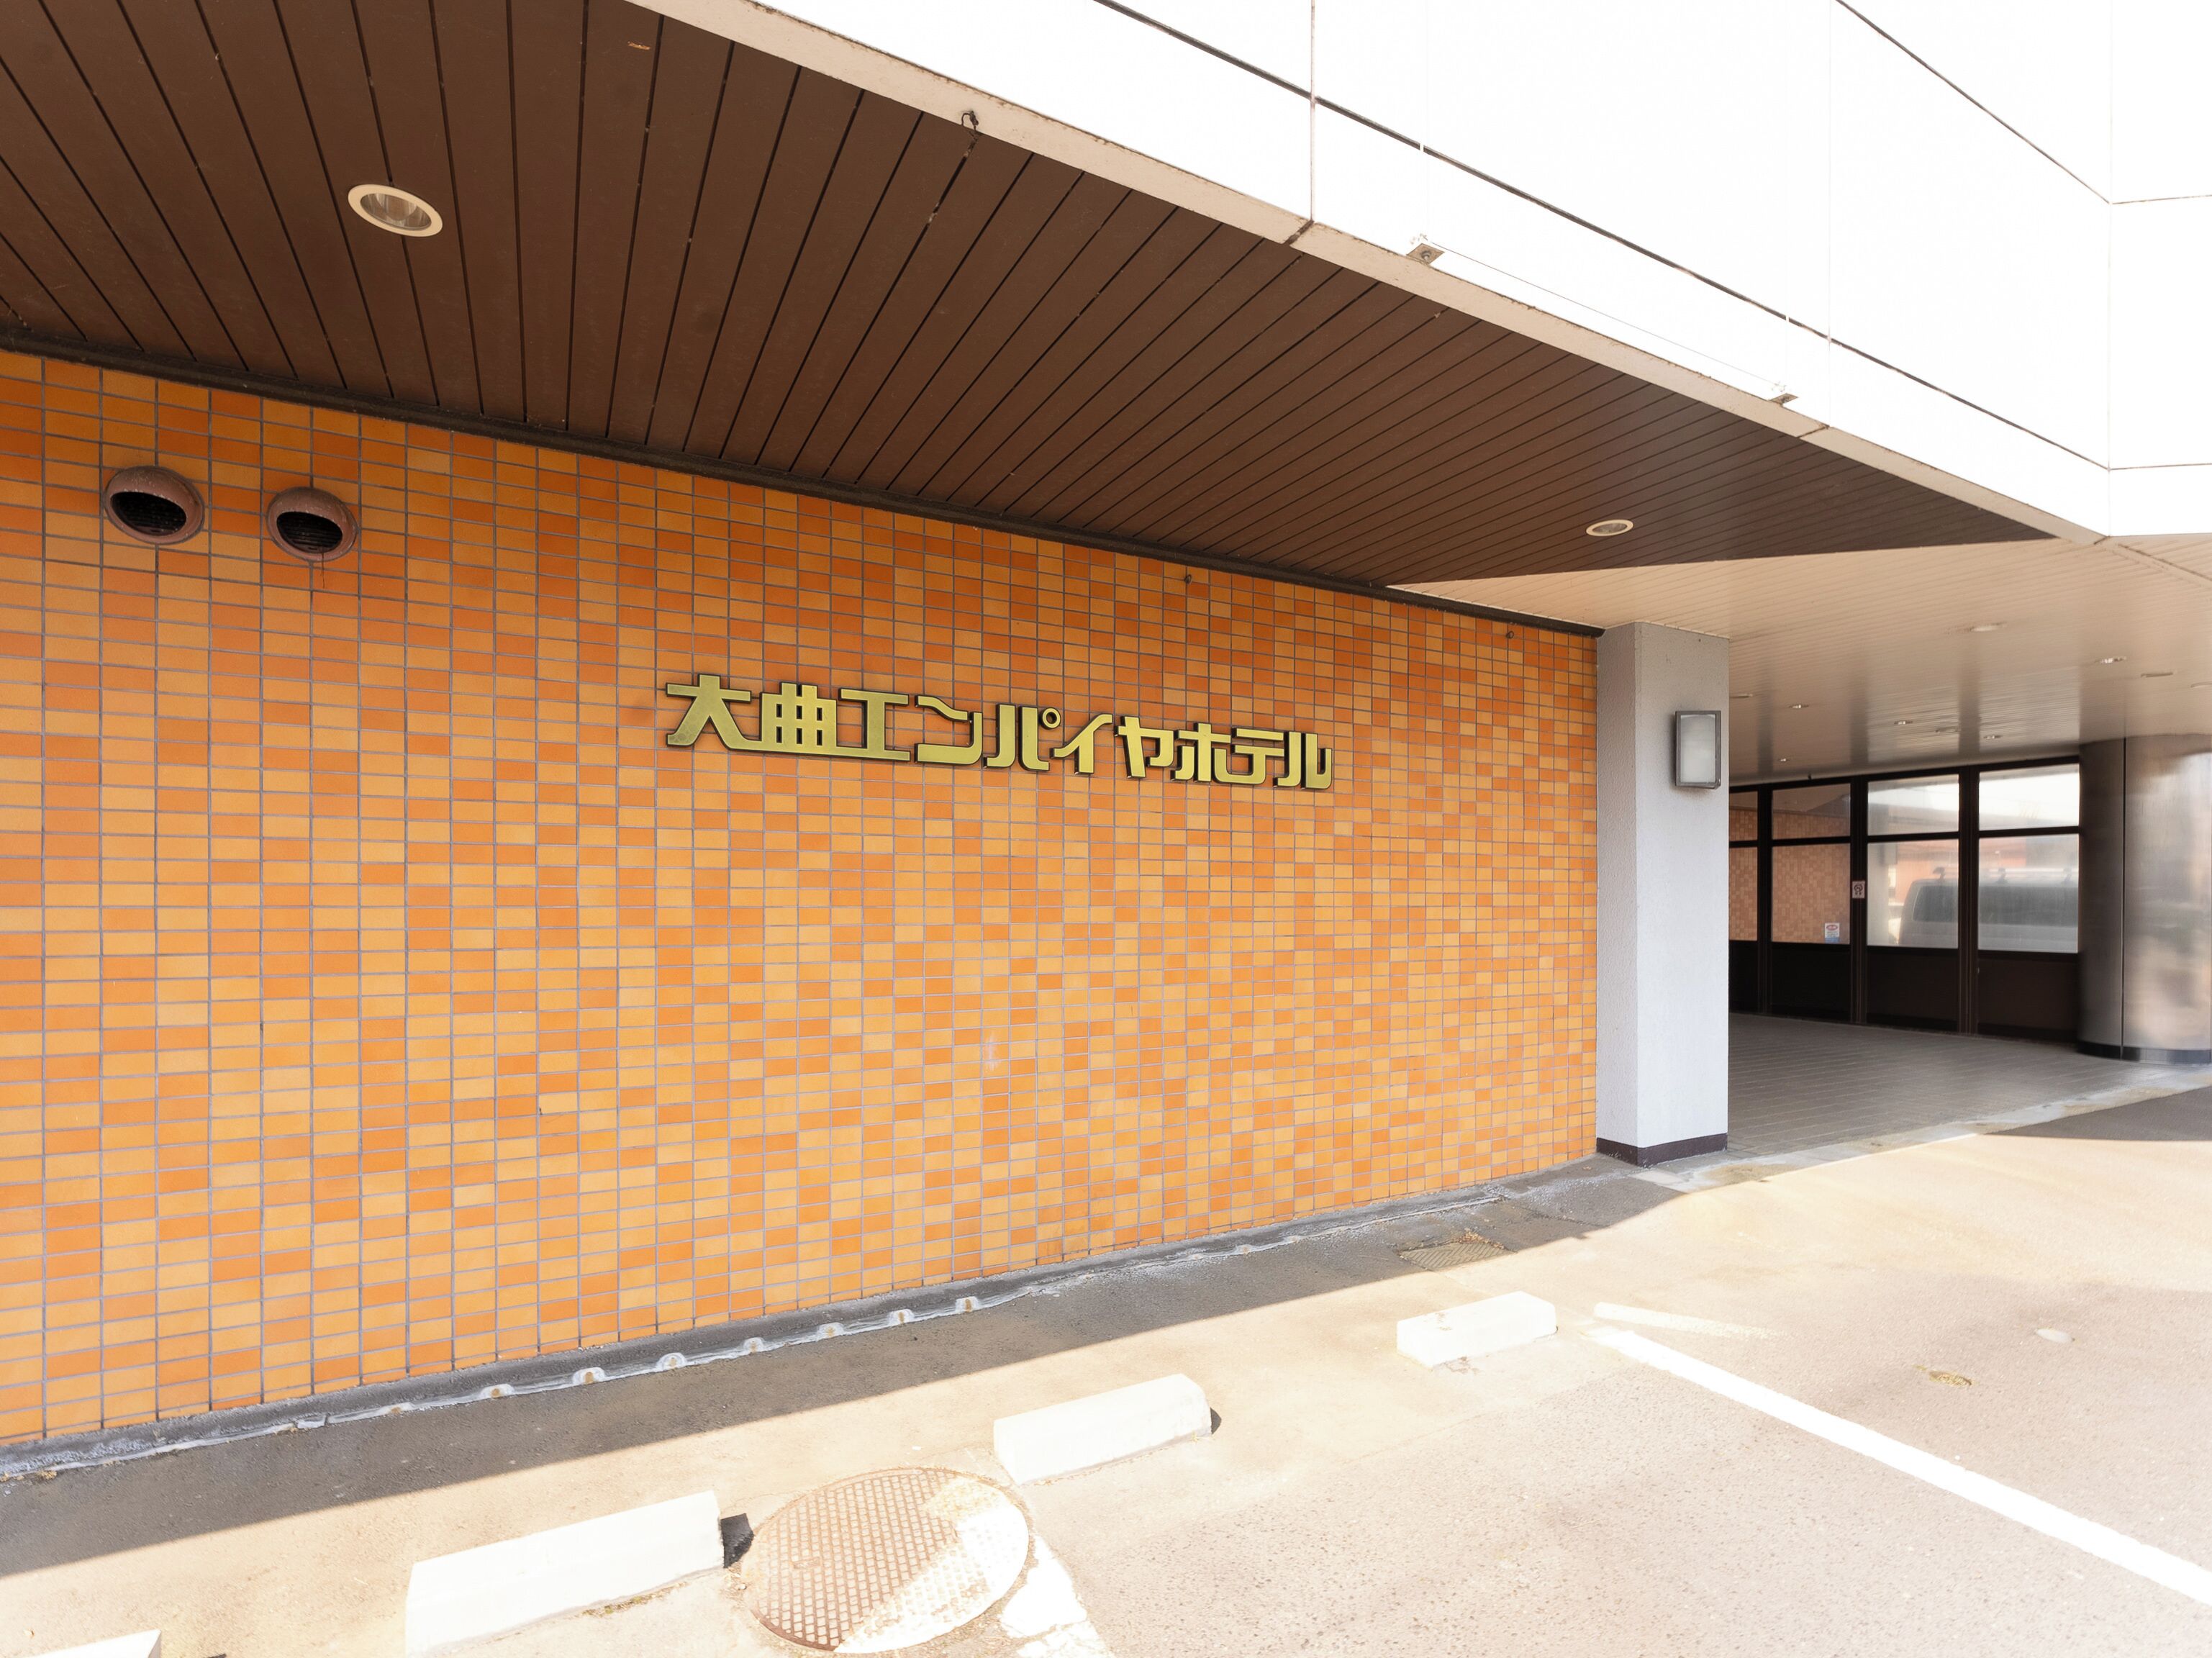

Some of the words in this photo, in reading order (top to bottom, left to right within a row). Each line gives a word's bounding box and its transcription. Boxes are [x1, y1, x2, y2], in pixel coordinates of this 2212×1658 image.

[666, 674, 1333, 789] 大曲エンパイヤホテル
